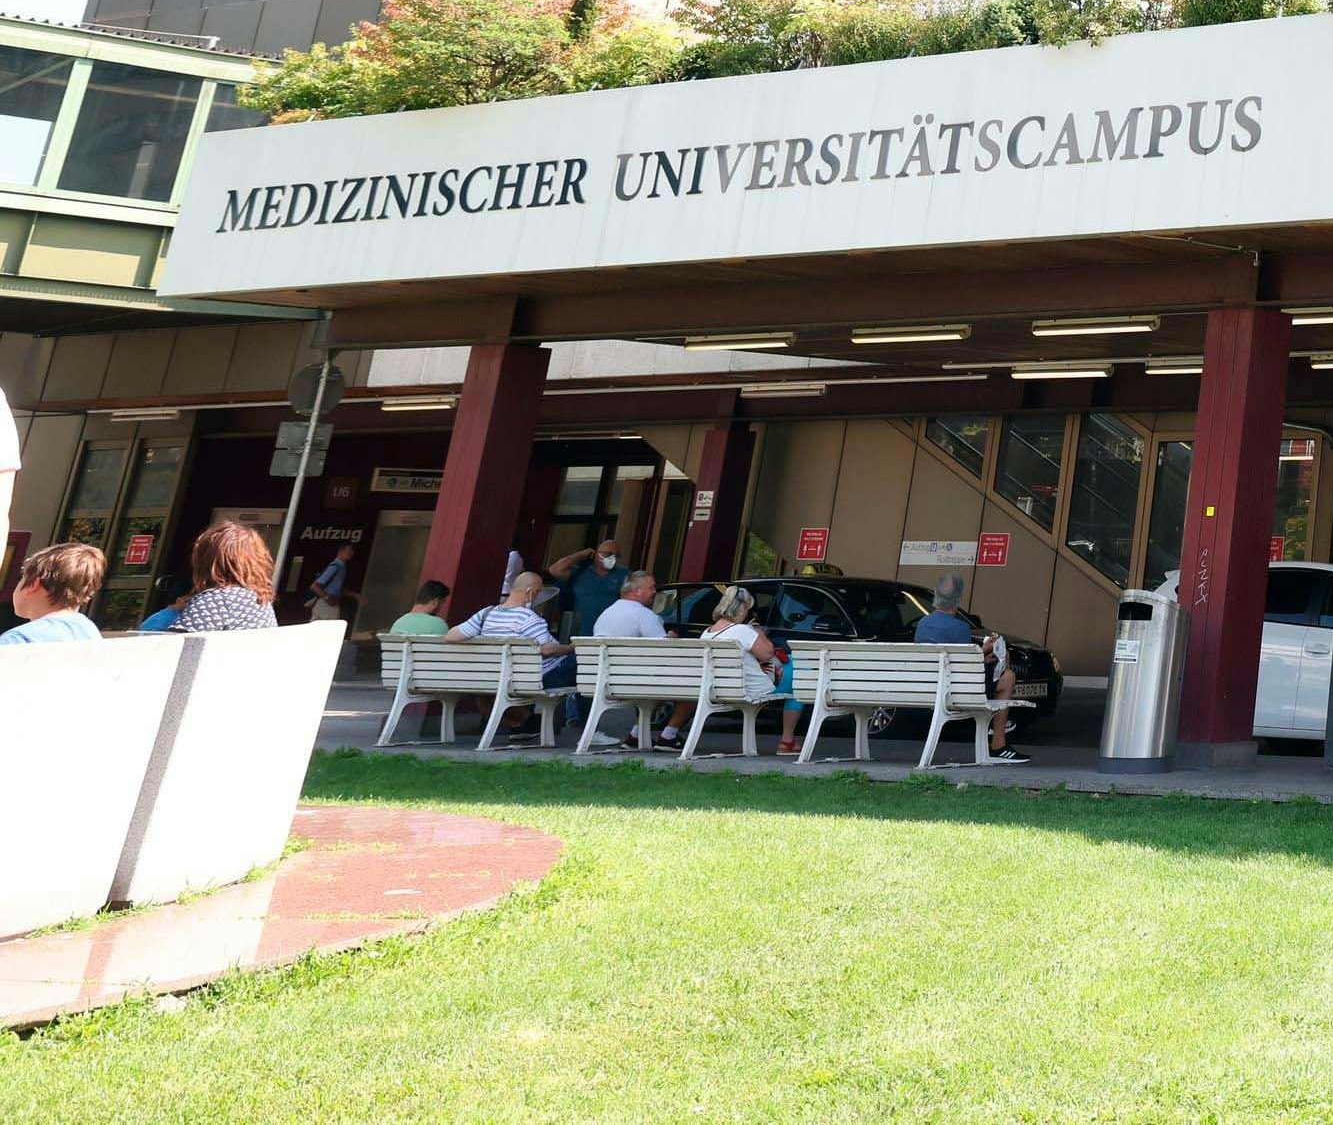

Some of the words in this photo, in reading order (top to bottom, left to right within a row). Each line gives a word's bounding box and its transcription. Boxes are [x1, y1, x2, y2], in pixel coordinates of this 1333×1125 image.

[215, 157, 588, 233] MEDIZINISCHER
[614, 96, 1263, 201] UNIVERSITÄTSCAMPUS
[301, 526, 364, 542] Aufzug
